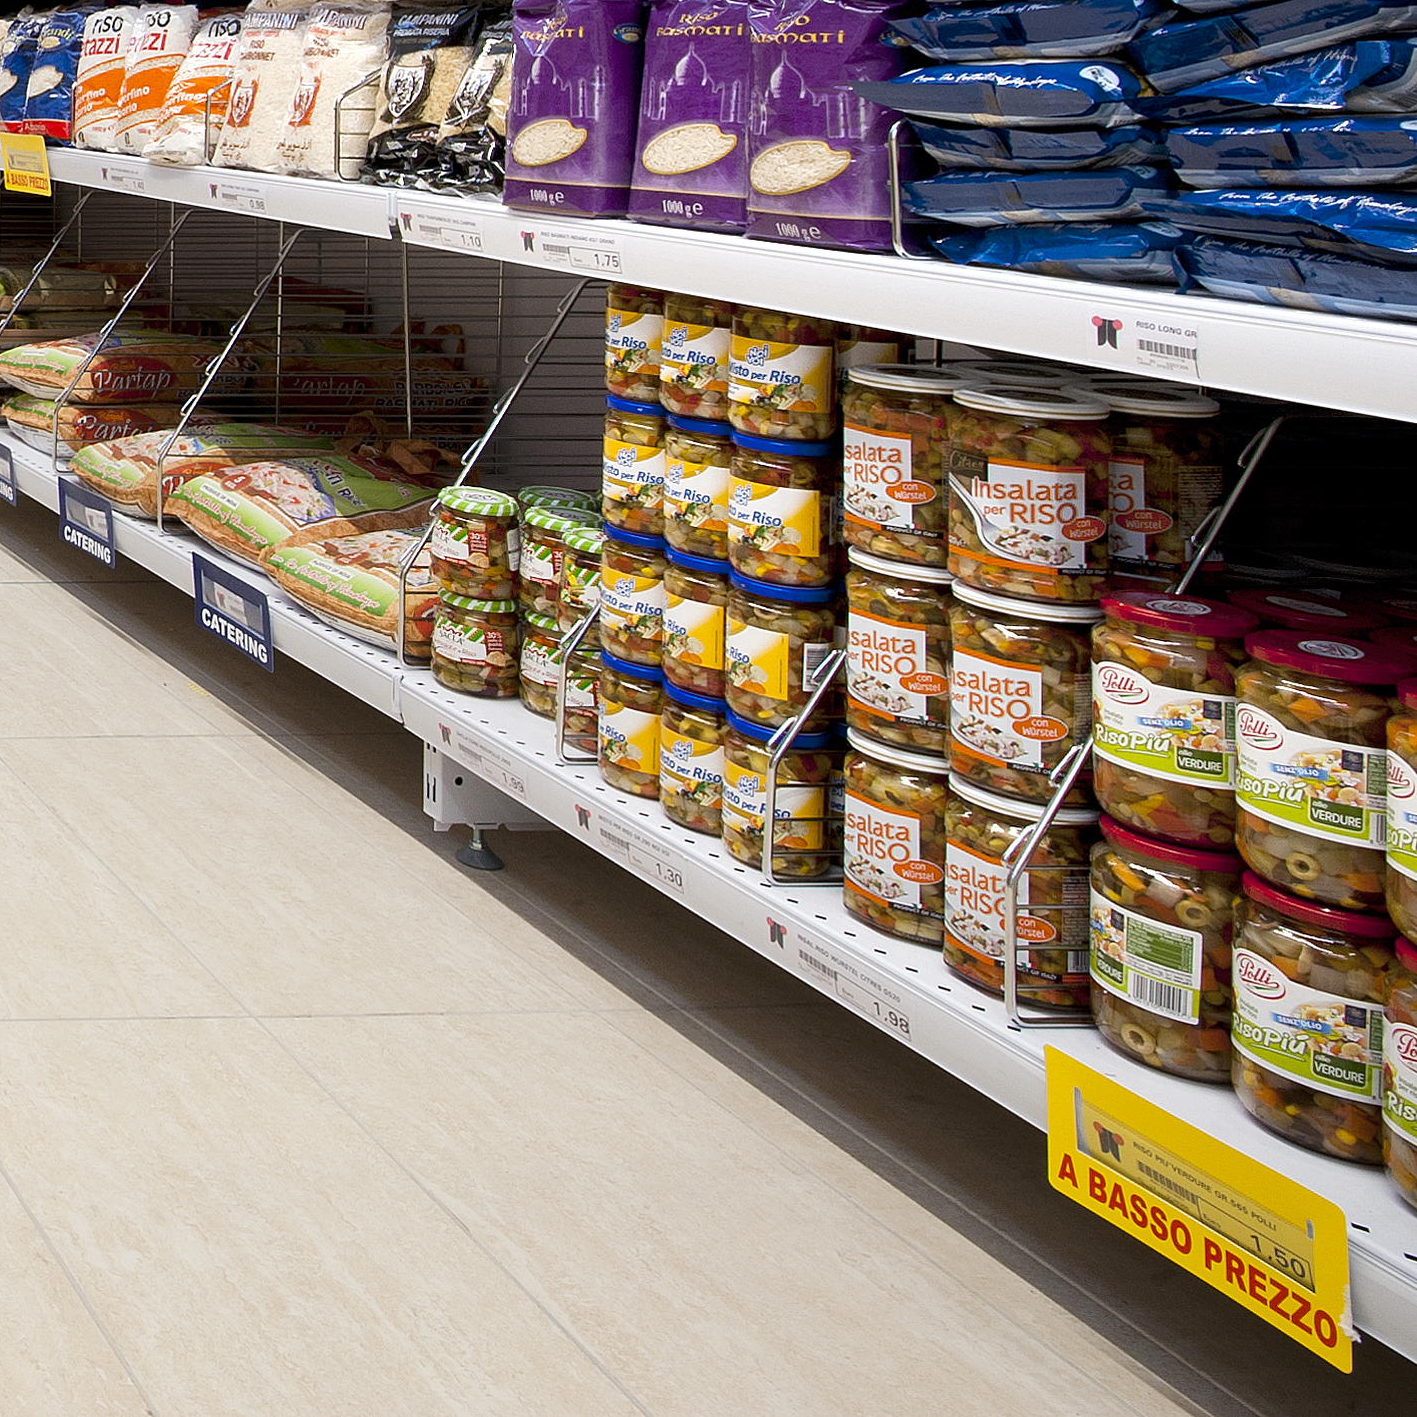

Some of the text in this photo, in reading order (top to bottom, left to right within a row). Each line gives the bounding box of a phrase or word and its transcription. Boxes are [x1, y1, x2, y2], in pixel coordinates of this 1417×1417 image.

[208, 16, 242, 39] riso
[461, 235, 482, 248] 1,10
[775, 222, 800, 239] 1000
[595, 254, 620, 269] 1,75
[1135, 321, 1197, 338] RISO LONG GR
[636, 472, 664, 487] Riso
[852, 460, 903, 485] RISO
[972, 475, 1079, 504] Insalata
[984, 499, 1078, 527] per RISO
[63, 525, 113, 565] CATERING
[201, 609, 269, 665] CATERING
[861, 649, 917, 674] RISO
[1103, 671, 1138, 691] Polli
[969, 693, 1033, 720] RISO
[1020, 722, 1061, 740] Würstel
[1238, 713, 1275, 742] Polli
[694, 766, 723, 783] Riso
[1177, 755, 1225, 774] VERDURE
[1310, 805, 1364, 825] VERDURE
[857, 835, 911, 864] RISO
[655, 863, 683, 887] 1,30
[1238, 957, 1275, 985] Polli
[873, 999, 911, 1034] 1,98
[1313, 1057, 1366, 1083] VERDURE
[1058, 1153, 1337, 1348] A BASSO PREZZO
[1250, 1232, 1307, 1281] 1,50
